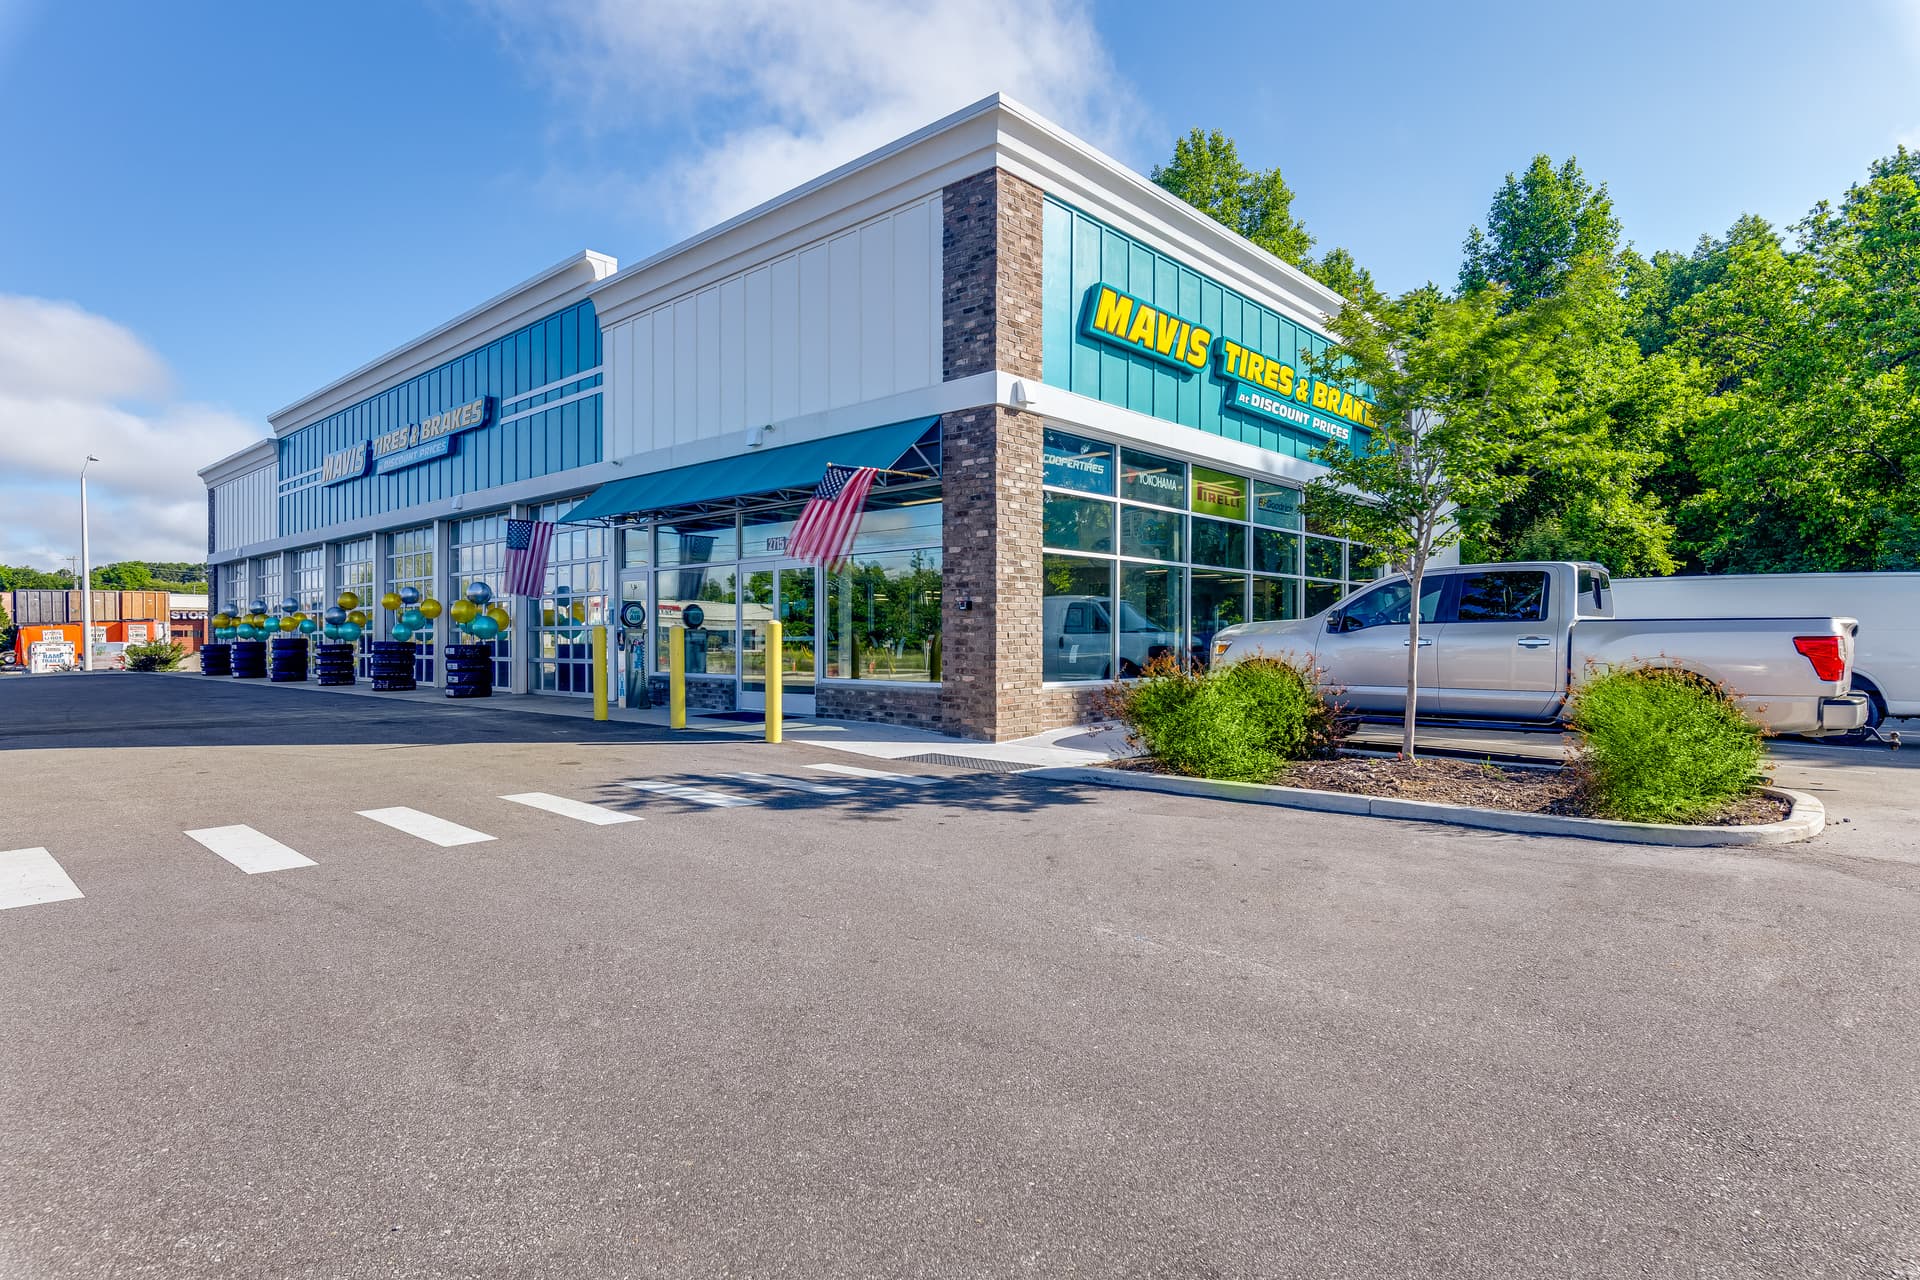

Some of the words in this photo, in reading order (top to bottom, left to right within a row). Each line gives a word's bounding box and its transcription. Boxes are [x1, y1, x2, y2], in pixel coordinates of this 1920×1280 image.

[1093, 287, 1212, 368] MAVIS
[1225, 340, 1294, 396] TIRES
[1295, 378, 1309, 403] &
[1312, 380, 1377, 428] BRAKE
[1250, 393, 1310, 426] DISCOUNT
[1312, 416, 1349, 440] PRICES
[322, 443, 367, 482] MAVIS
[373, 429, 408, 457] TIRES
[421, 399, 483, 439] BRAKES
[1043, 453, 1105, 475] COOPERTIRES
[1139, 471, 1177, 491] YOKOHAMA
[1197, 481, 1240, 508] PIRELLI
[767, 537, 785, 551] 2715
